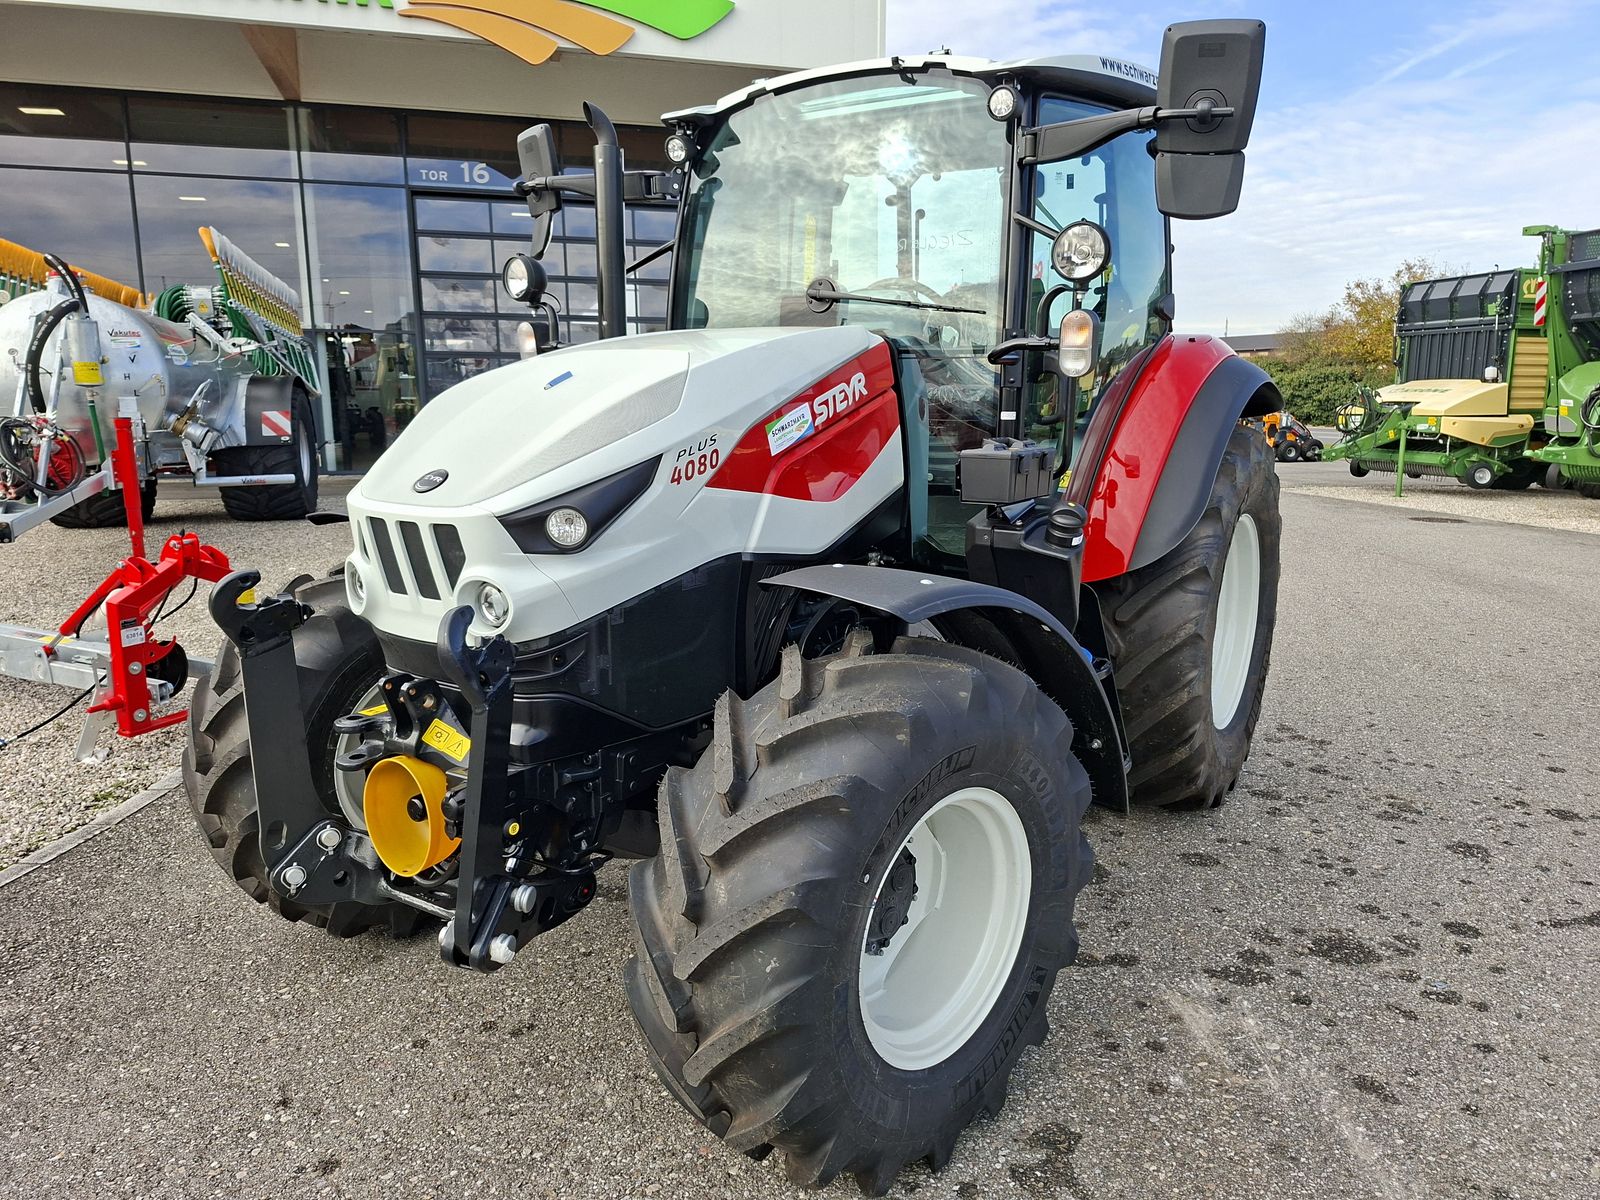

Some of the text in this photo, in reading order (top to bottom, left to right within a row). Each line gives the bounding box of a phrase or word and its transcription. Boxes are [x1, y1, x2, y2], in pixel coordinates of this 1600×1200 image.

[1099, 56, 1158, 86] www.schwarz
[419, 161, 490, 184] TOR 16
[107, 328, 142, 337] Vakutec
[813, 372, 868, 427] STEYR
[771, 413, 806, 438] SCHWARZMAYR
[676, 433, 718, 462] PLUS
[670, 448, 720, 485] 4080
